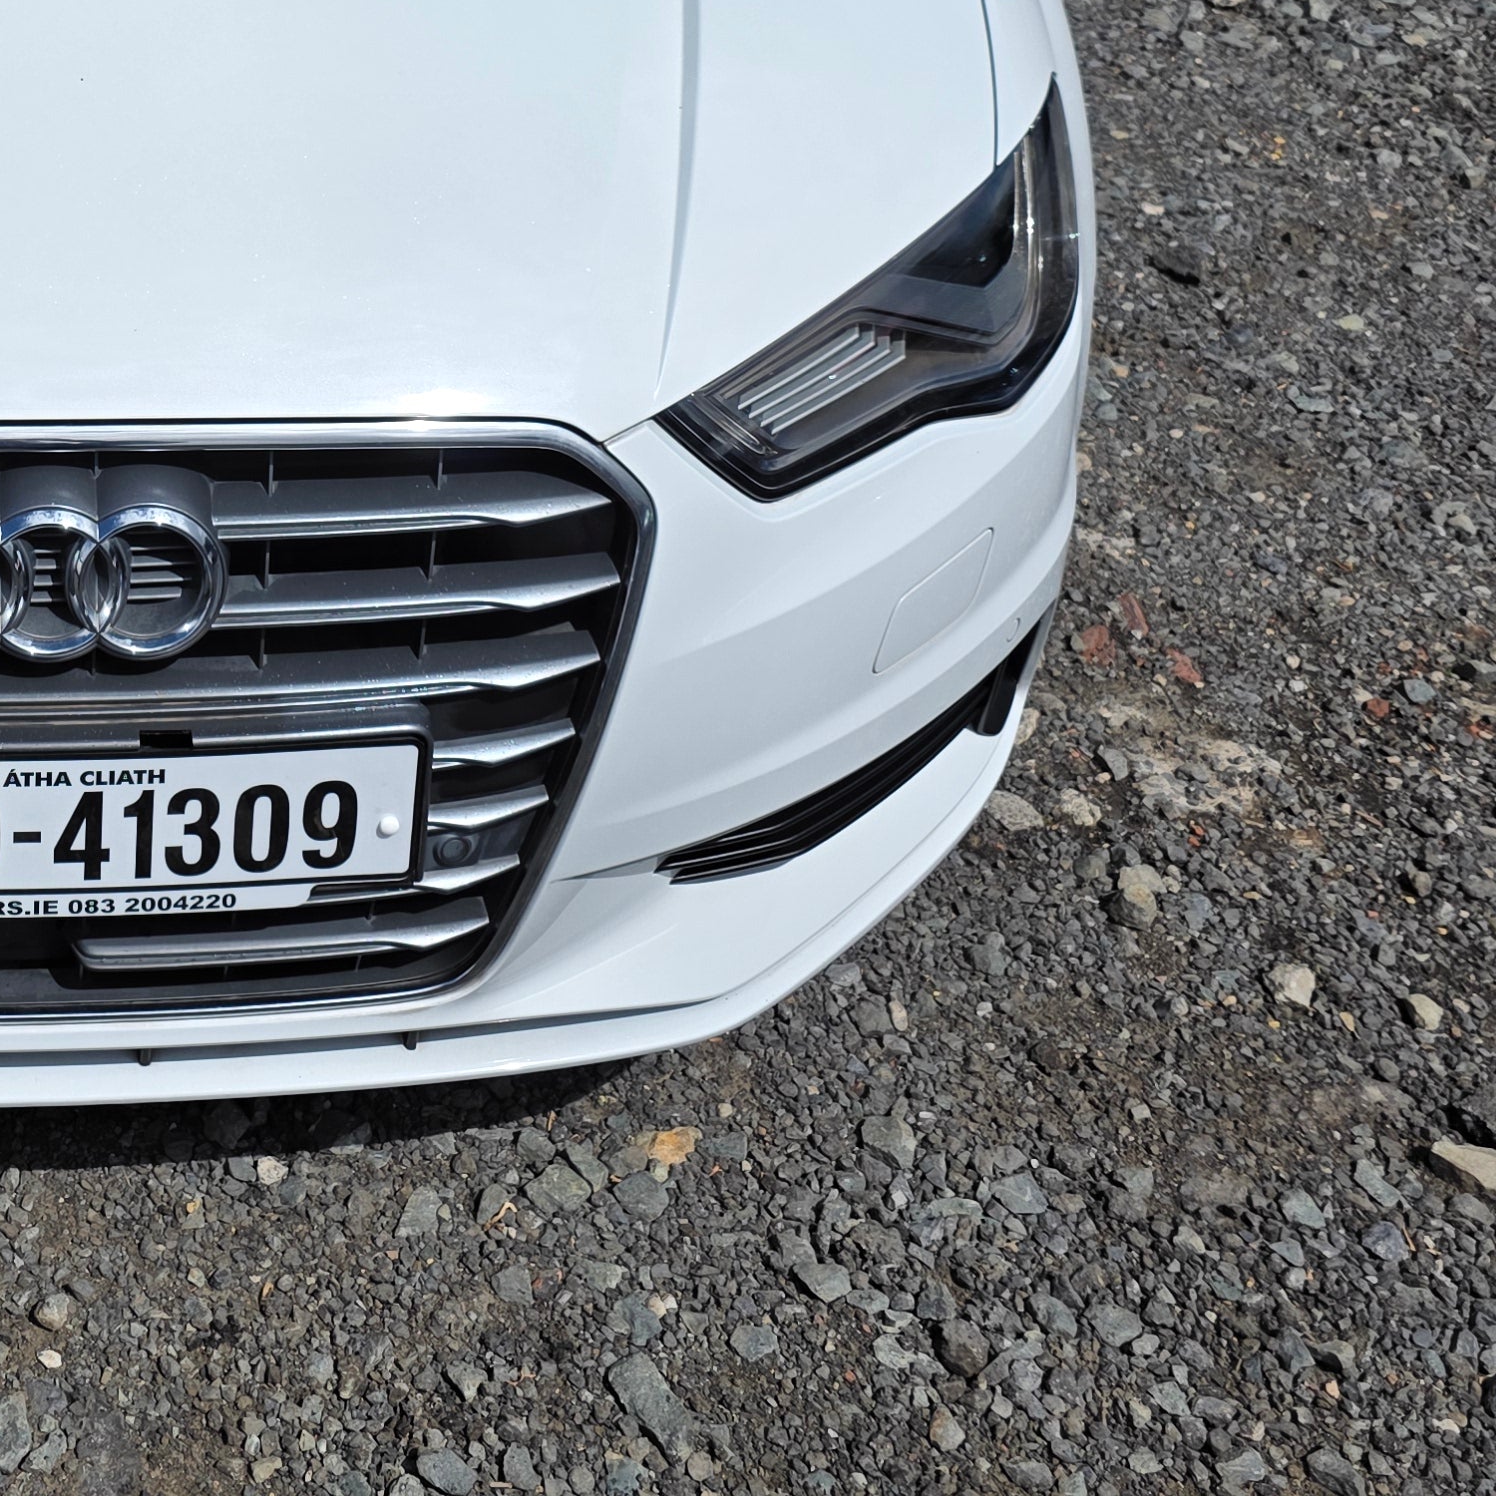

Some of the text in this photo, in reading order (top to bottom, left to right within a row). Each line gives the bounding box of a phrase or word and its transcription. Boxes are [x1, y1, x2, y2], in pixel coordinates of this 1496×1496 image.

[2, 768, 72, 788] ÁTHA
[80, 768, 166, 786] CLIATH
[68, 898, 116, 915] 083
[124, 893, 237, 913] 2004220
